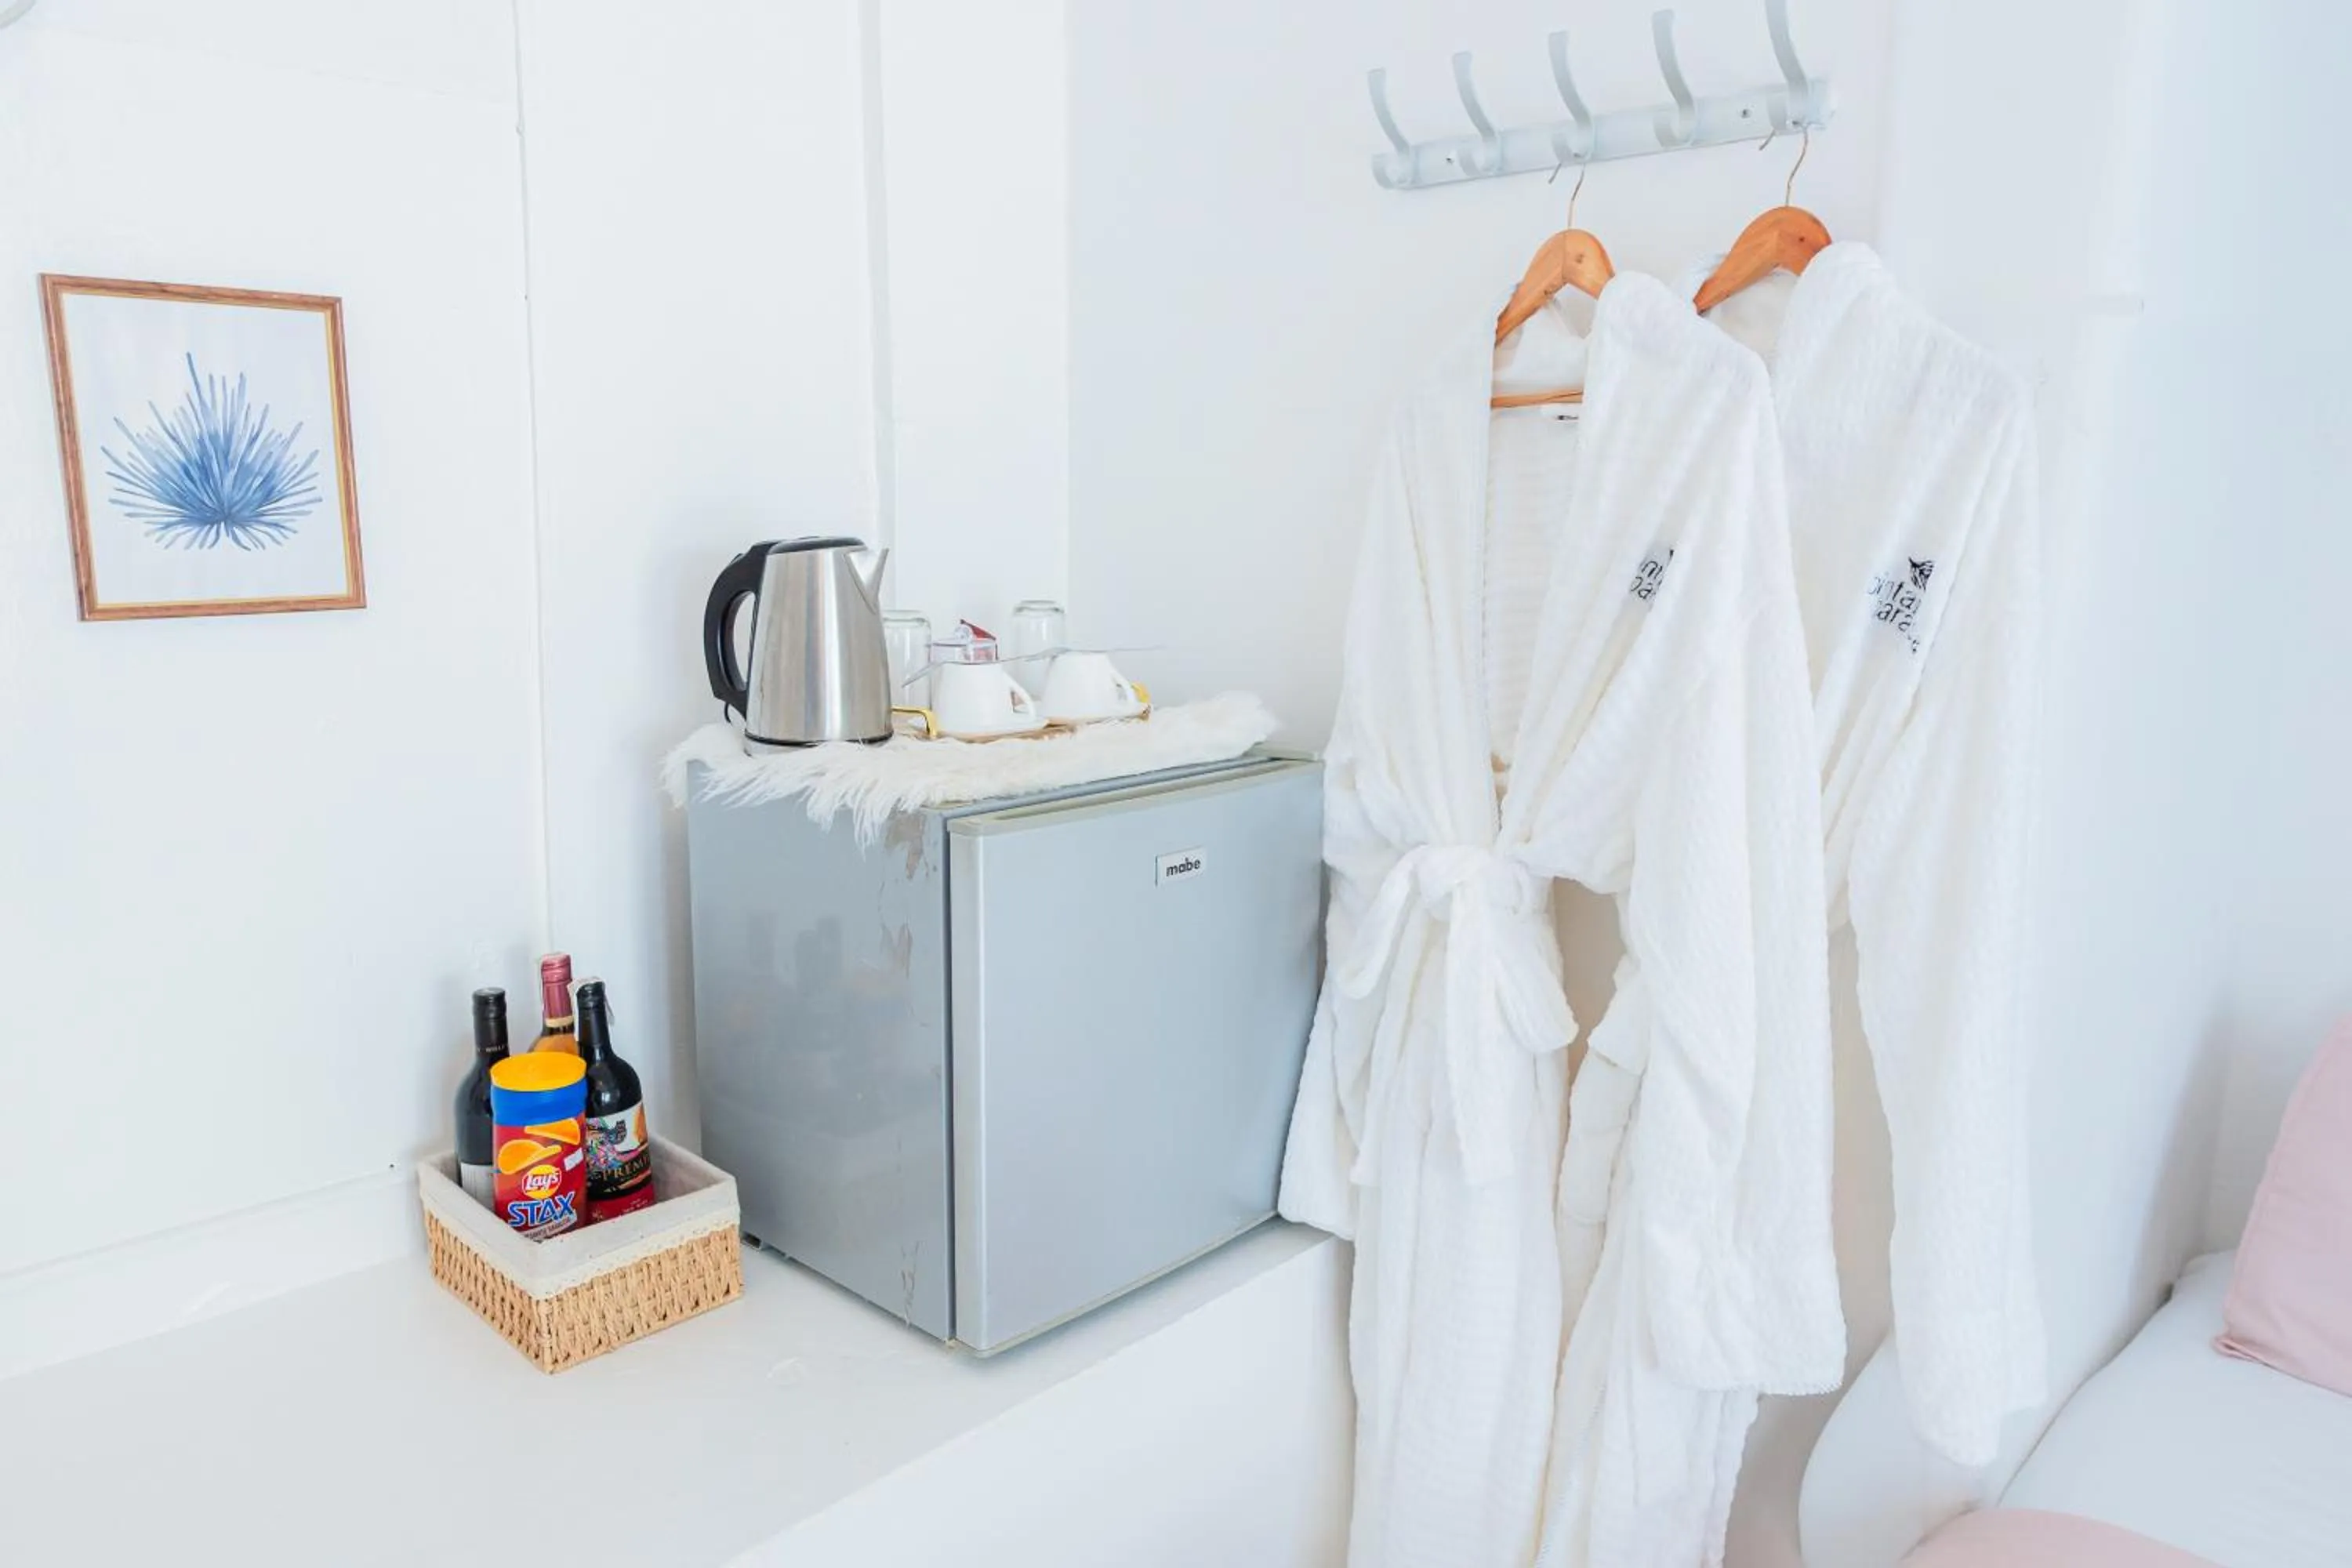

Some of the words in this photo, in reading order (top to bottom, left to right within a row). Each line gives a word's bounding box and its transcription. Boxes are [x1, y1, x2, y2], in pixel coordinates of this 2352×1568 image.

[1166, 857, 1201, 877] mabe
[524, 1170, 560, 1191] Lay's
[508, 1191, 576, 1227] STAX
